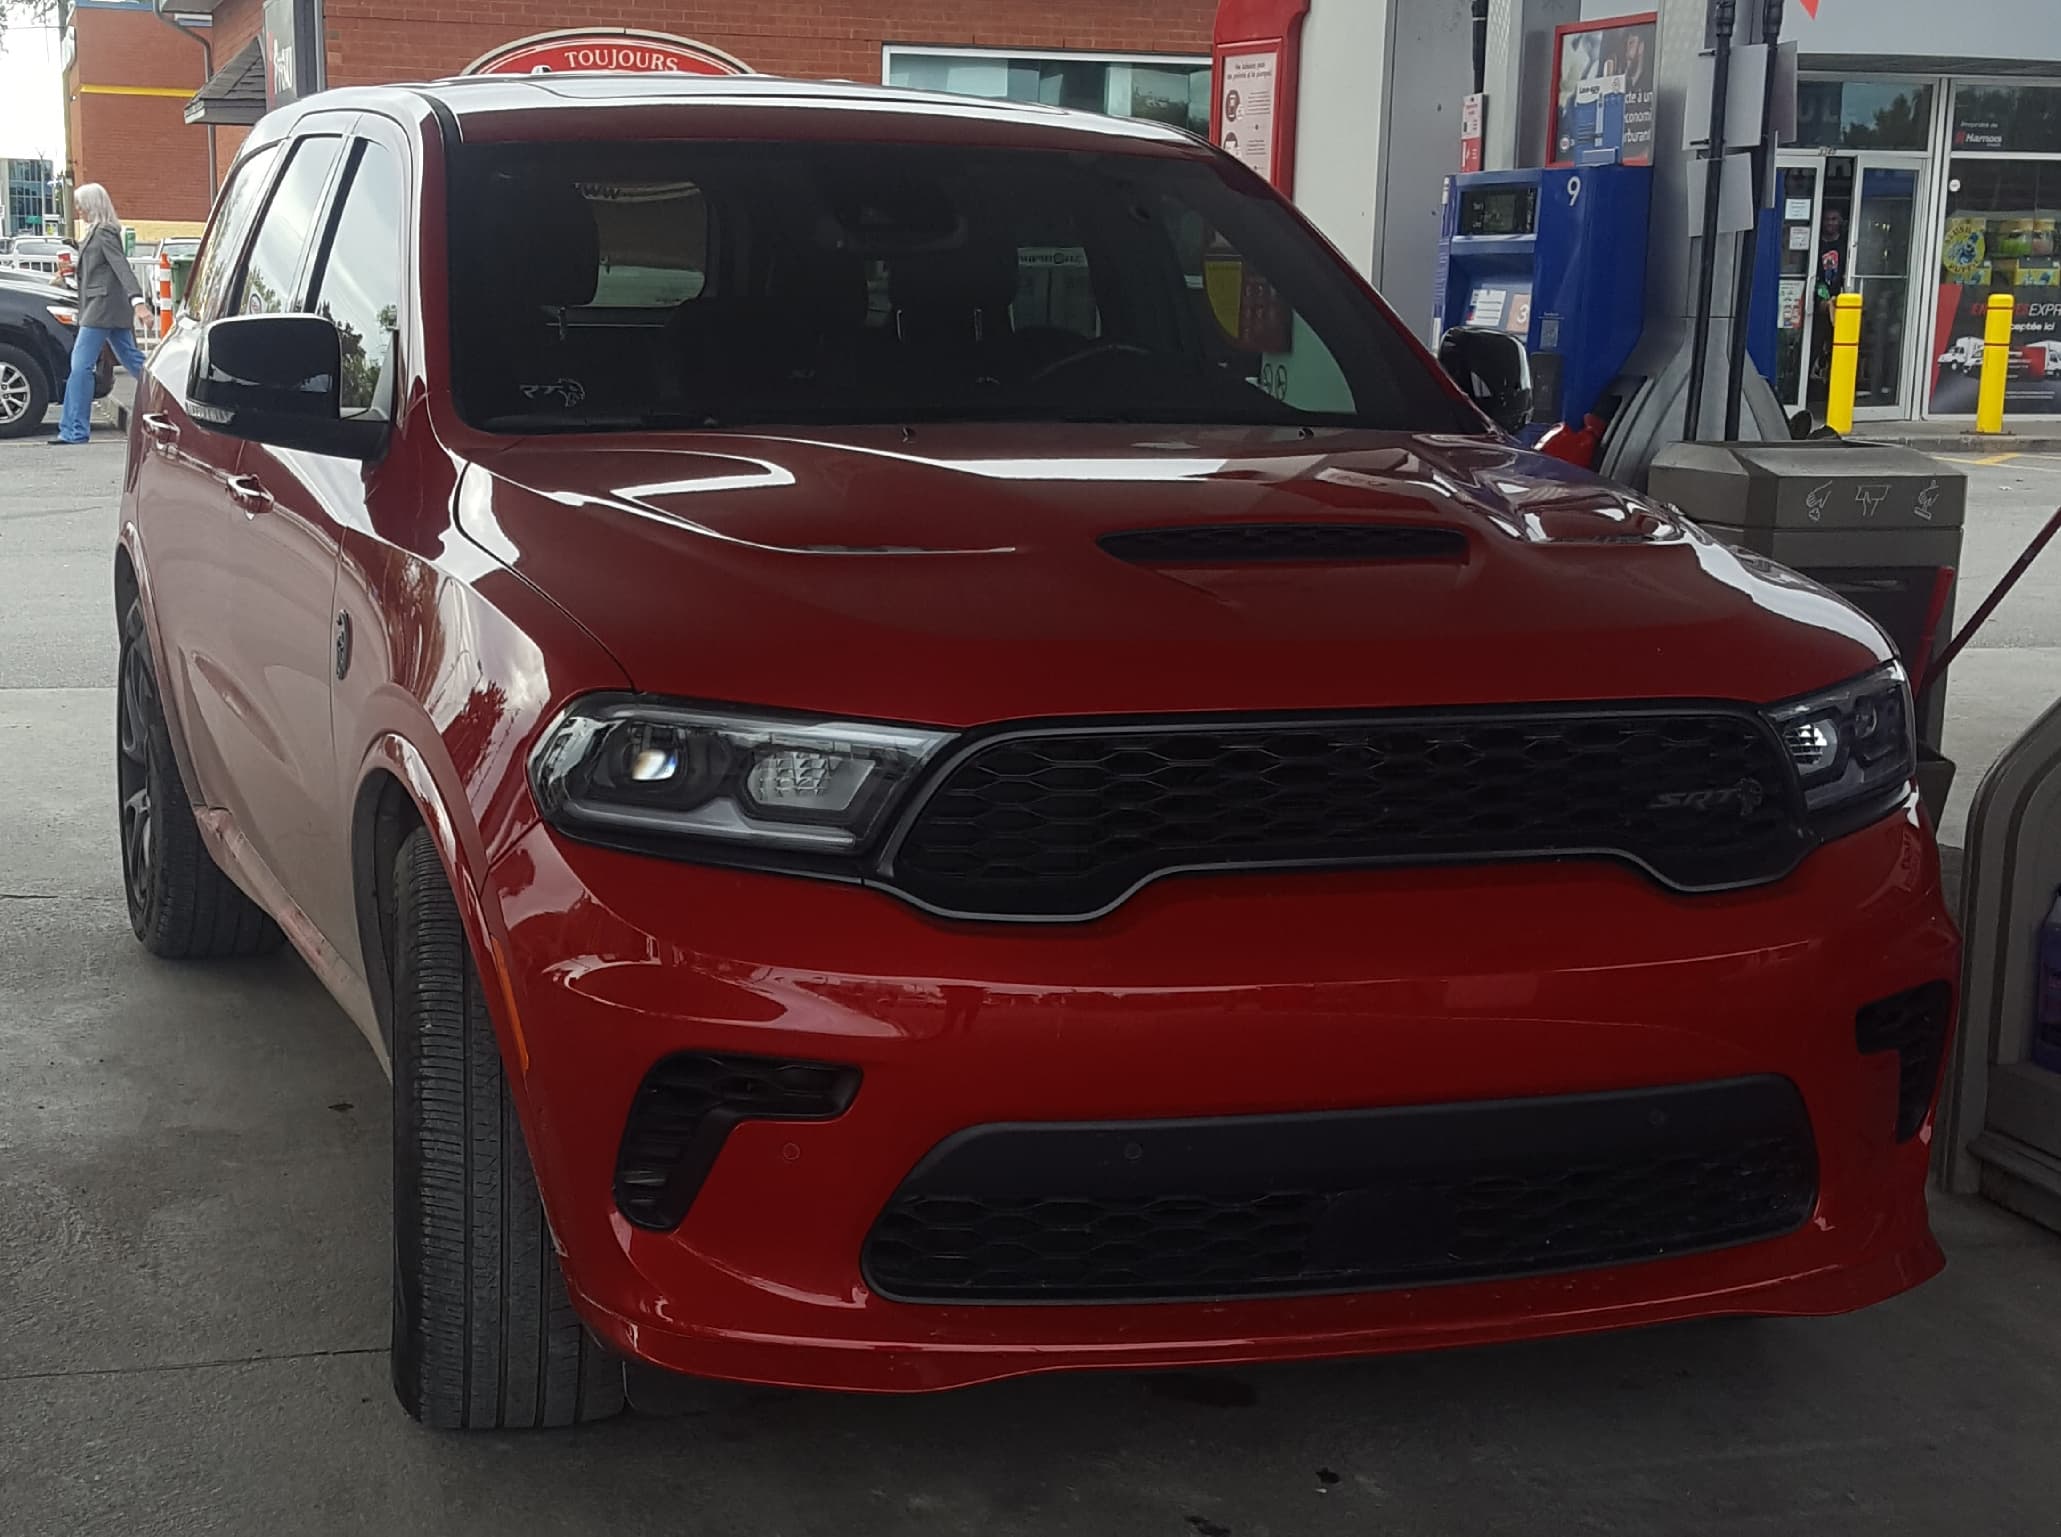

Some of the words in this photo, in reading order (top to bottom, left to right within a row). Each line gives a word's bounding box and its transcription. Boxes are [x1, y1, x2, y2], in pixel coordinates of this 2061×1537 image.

[564, 48, 679, 72] TOUJOURS
[1567, 175, 1582, 207] 9
[1516, 303, 1530, 324] 3
[1646, 788, 1737, 811] SRT
